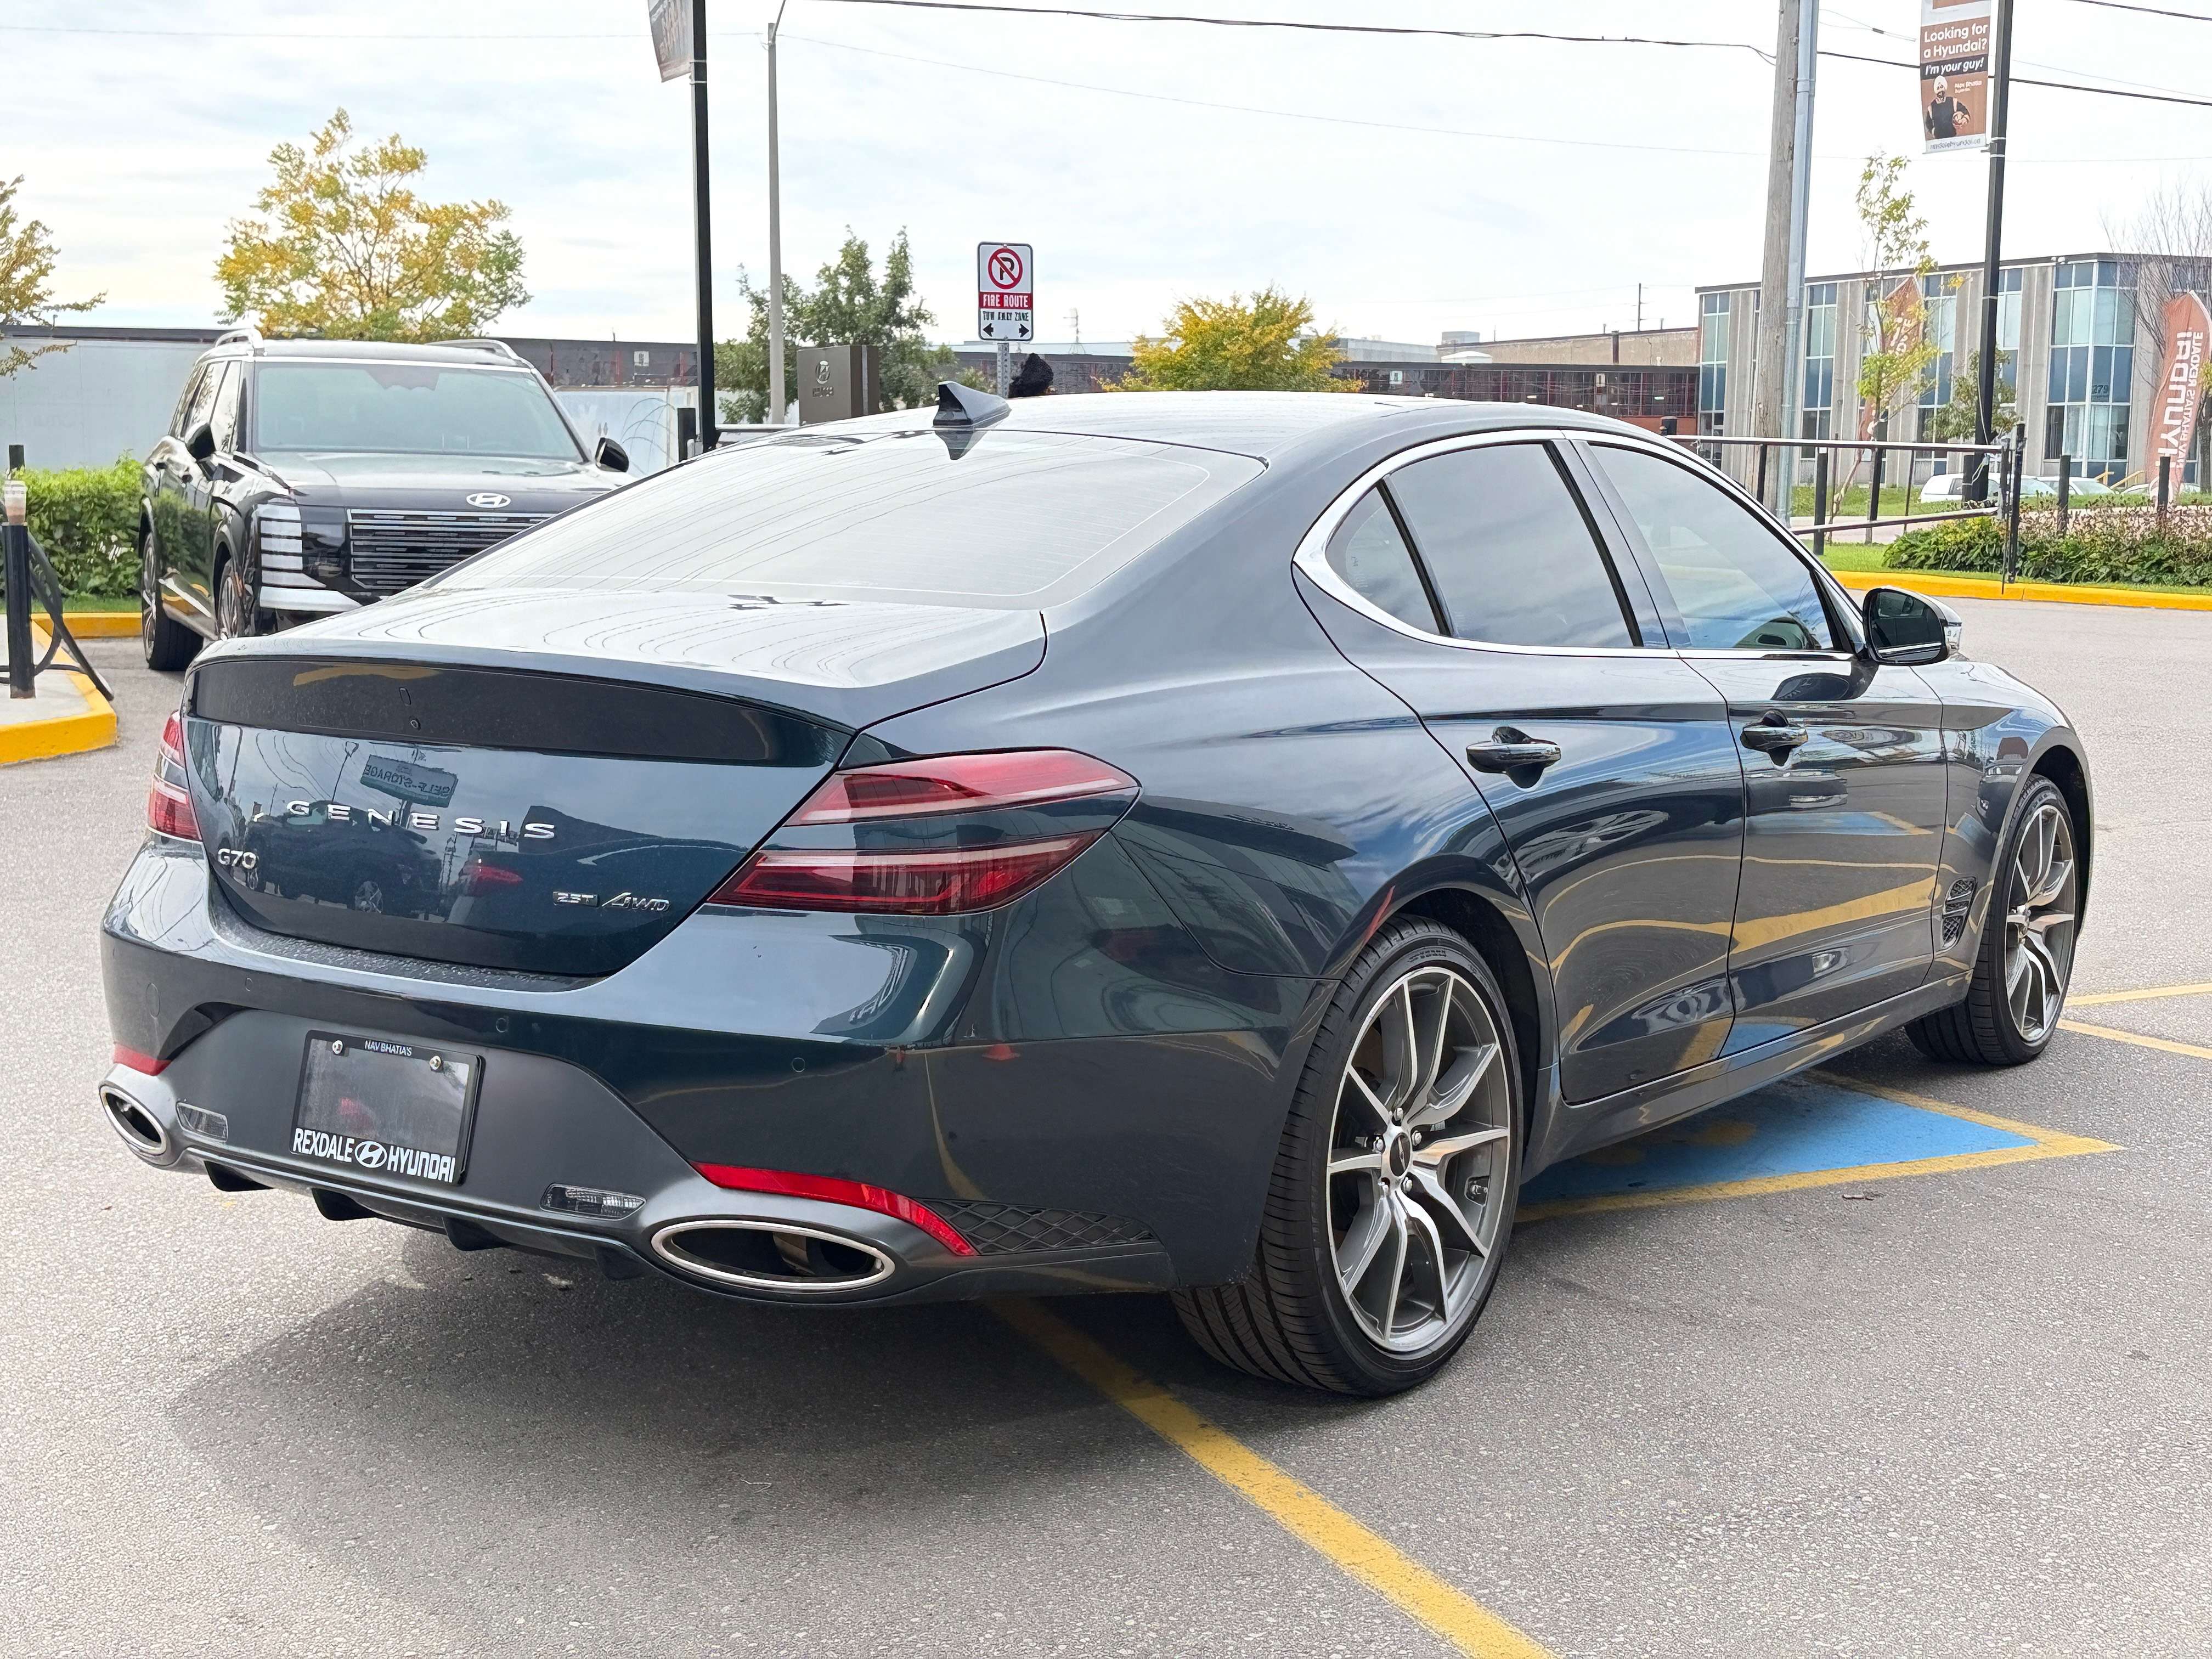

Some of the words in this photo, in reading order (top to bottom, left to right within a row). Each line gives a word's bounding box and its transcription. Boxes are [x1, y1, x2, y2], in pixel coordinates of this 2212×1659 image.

[1924, 26, 1969, 43] Looking
[1971, 23, 1988, 35] for
[1923, 48, 1931, 58] a
[1933, 38, 1987, 58] Hyundai?
[1925, 65, 1939, 75] I'm
[1940, 62, 1962, 75] your
[1962, 57, 1984, 72] guy!
[983, 294, 1001, 307] FIRE
[1003, 295, 1029, 308] ROUTE
[286, 800, 555, 839] GENESIS
[217, 848, 257, 869] G70
[602, 892, 670, 911] AWD
[364, 1040, 380, 1051] NAV
[380, 1042, 412, 1057] BHATIA'S
[293, 1127, 355, 1163] REXDALE
[387, 1146, 456, 1183] HYUNDAI
